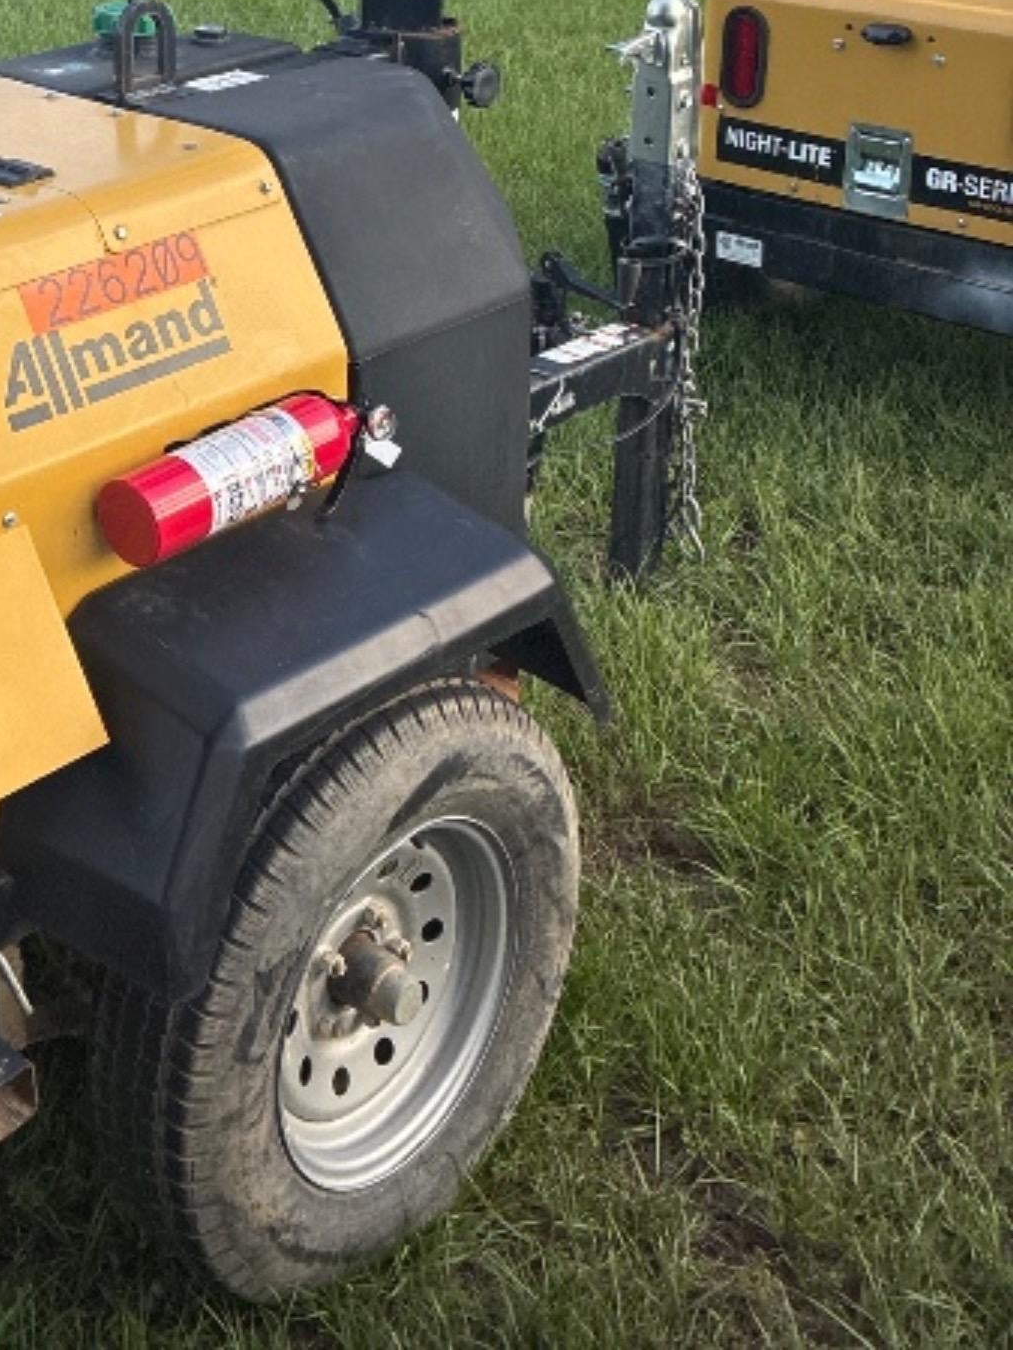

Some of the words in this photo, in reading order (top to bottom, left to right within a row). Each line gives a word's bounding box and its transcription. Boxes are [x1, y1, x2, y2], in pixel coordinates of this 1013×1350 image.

[725, 125, 832, 168] NIGHT-LITE
[38, 232, 199, 328] 226209
[4, 278, 225, 414] Allmand
